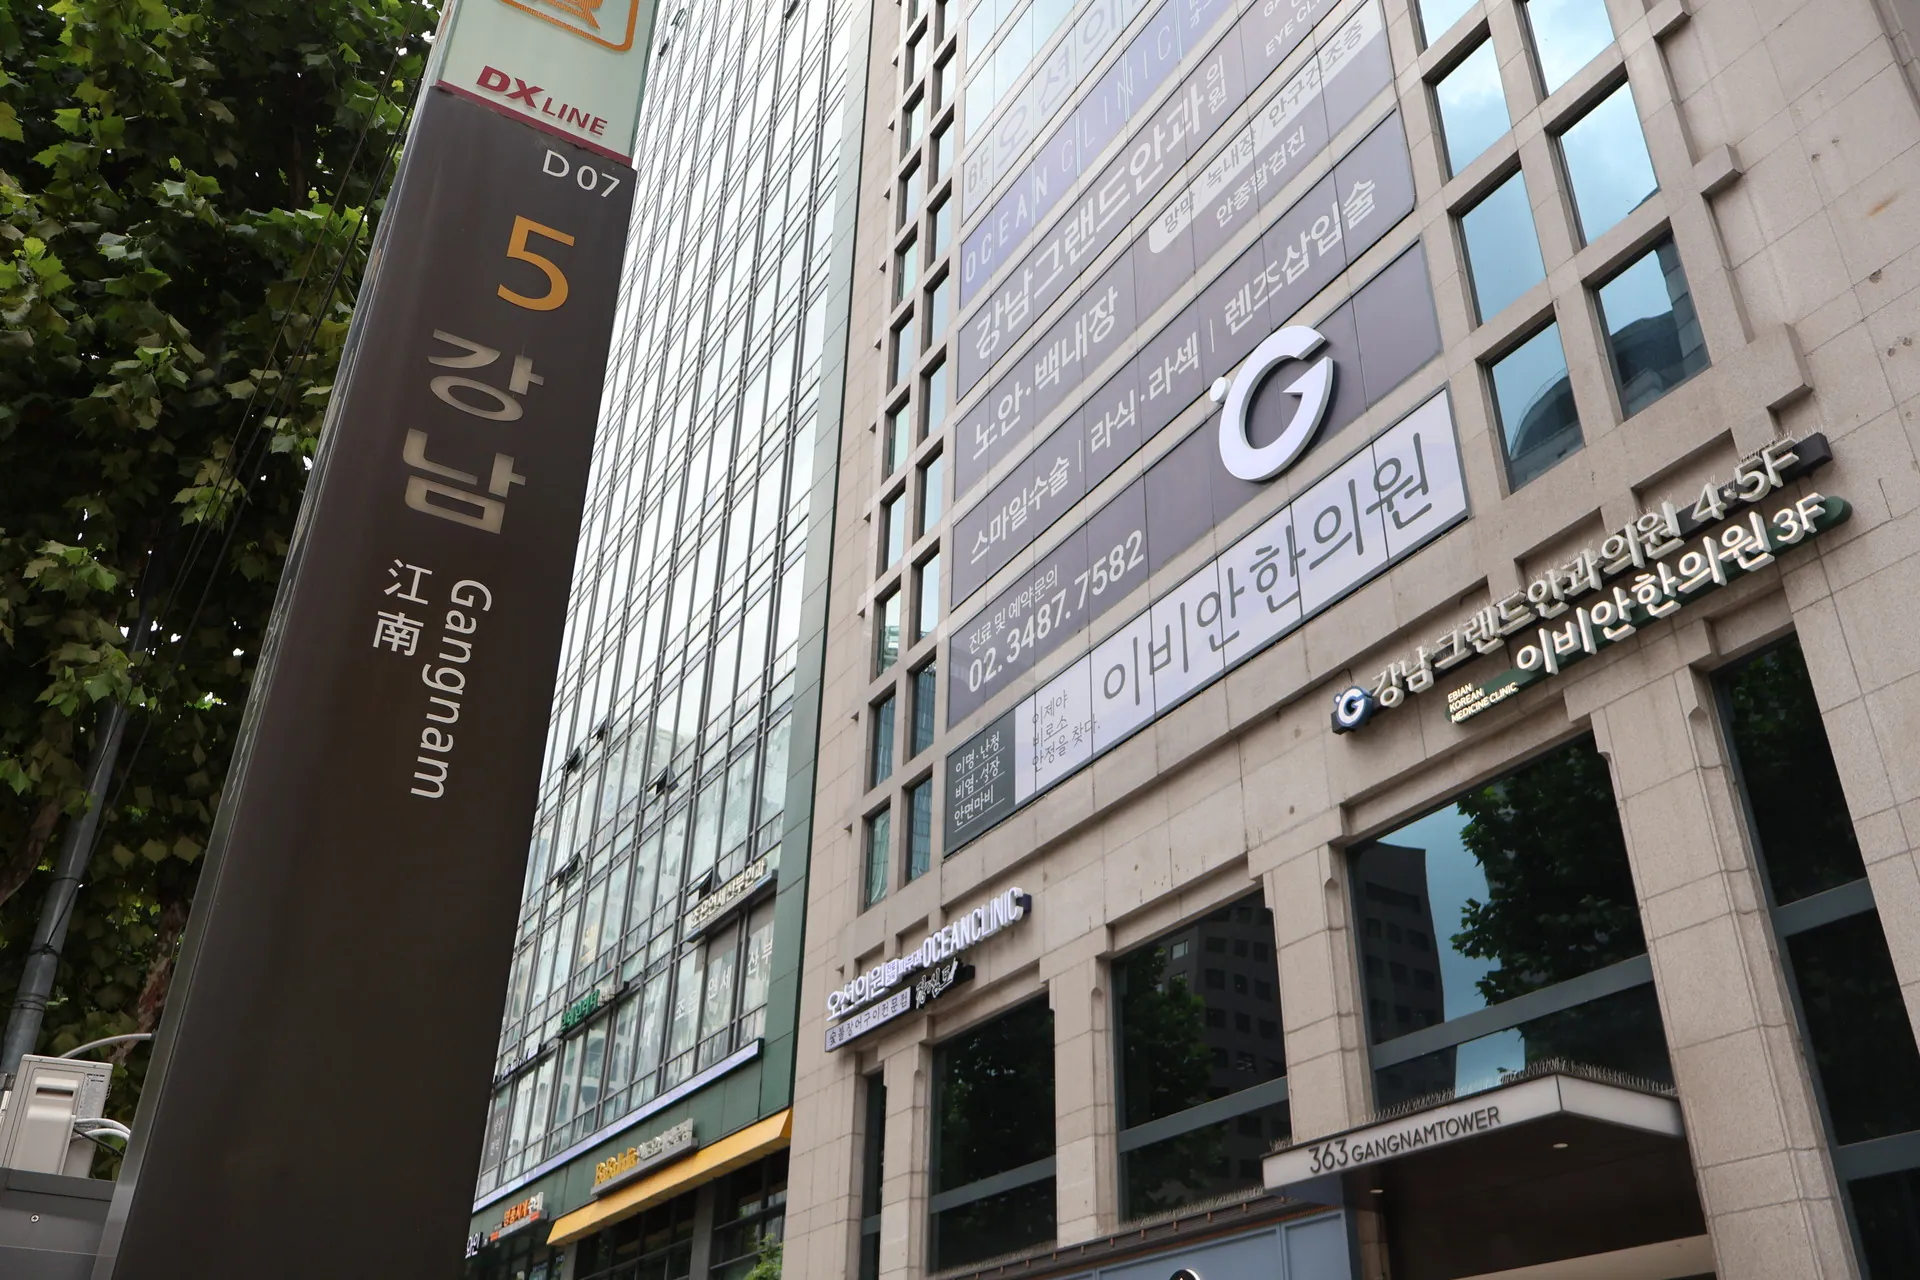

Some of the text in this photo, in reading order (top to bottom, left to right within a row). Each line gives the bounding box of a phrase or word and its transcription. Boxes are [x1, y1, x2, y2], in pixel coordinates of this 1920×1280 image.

[996, 0, 1142, 169] 오션의
[1265, 18, 1294, 58] EYE
[1164, 188, 1196, 234] 망막
[1206, 127, 1257, 189] 녹내장
[1268, 19, 1363, 128] 안구건조증
[1216, 125, 1306, 229] 안종합검진
[497, 215, 575, 311] 5
[970, 456, 1069, 565] 스마일수술
[1224, 179, 1375, 335] 렌즈삽입술
[402, 328, 544, 535] 강남
[372, 558, 433, 657] 江南
[969, 564, 1058, 655] 진료 및 예약문의
[1103, 432, 1432, 706] 이비안한의원
[1372, 501, 1685, 708] 강남그랜드안과의원
[1516, 492, 1826, 675] 이비안한의원 3F
[411, 579, 492, 799] Gangnam
[1032, 689, 1068, 725] 이제야
[1032, 715, 1068, 747] 비로소
[1448, 683, 1473, 703] EBIAN
[1449, 687, 1485, 713] KOREAN
[1451, 681, 1518, 723] MEDICINE CLINIC
[1032, 735, 1069, 773] 안정을
[954, 784, 994, 827] 안면마비
[827, 962, 887, 1021] 오션의원
